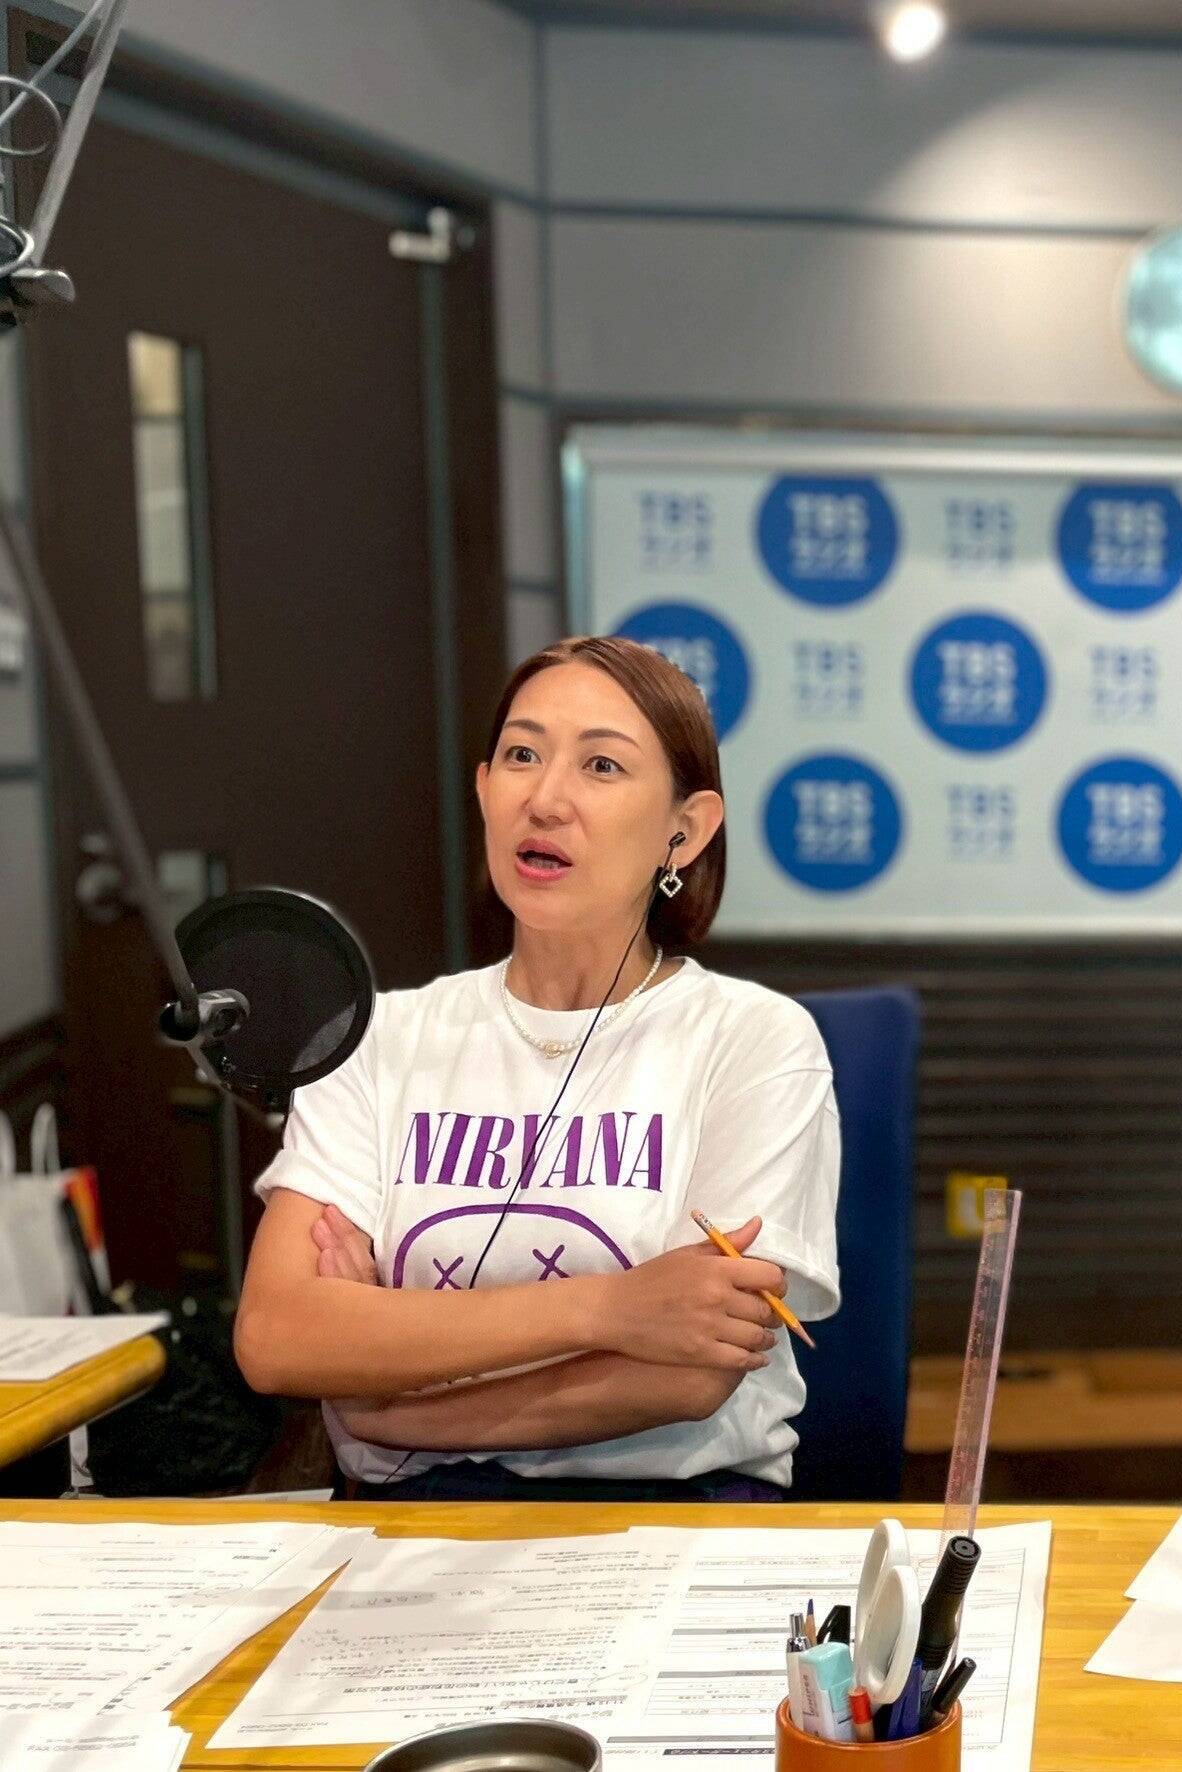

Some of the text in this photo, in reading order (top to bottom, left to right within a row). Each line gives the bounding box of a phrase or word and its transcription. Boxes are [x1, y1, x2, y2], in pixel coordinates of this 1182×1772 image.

[636, 490, 712, 527] TBS
[786, 492, 870, 534] TBS
[942, 498, 1018, 534] TBS
[1086, 500, 1167, 539] TBS
[791, 641, 865, 680] TBS
[935, 641, 1017, 683] TBS
[1089, 645, 1159, 683] TBS
[792, 779, 875, 821] TBS
[946, 783, 1017, 821] TBS
[1087, 782, 1166, 822] TBS
[394, 1111, 663, 1193] NIRVANA
